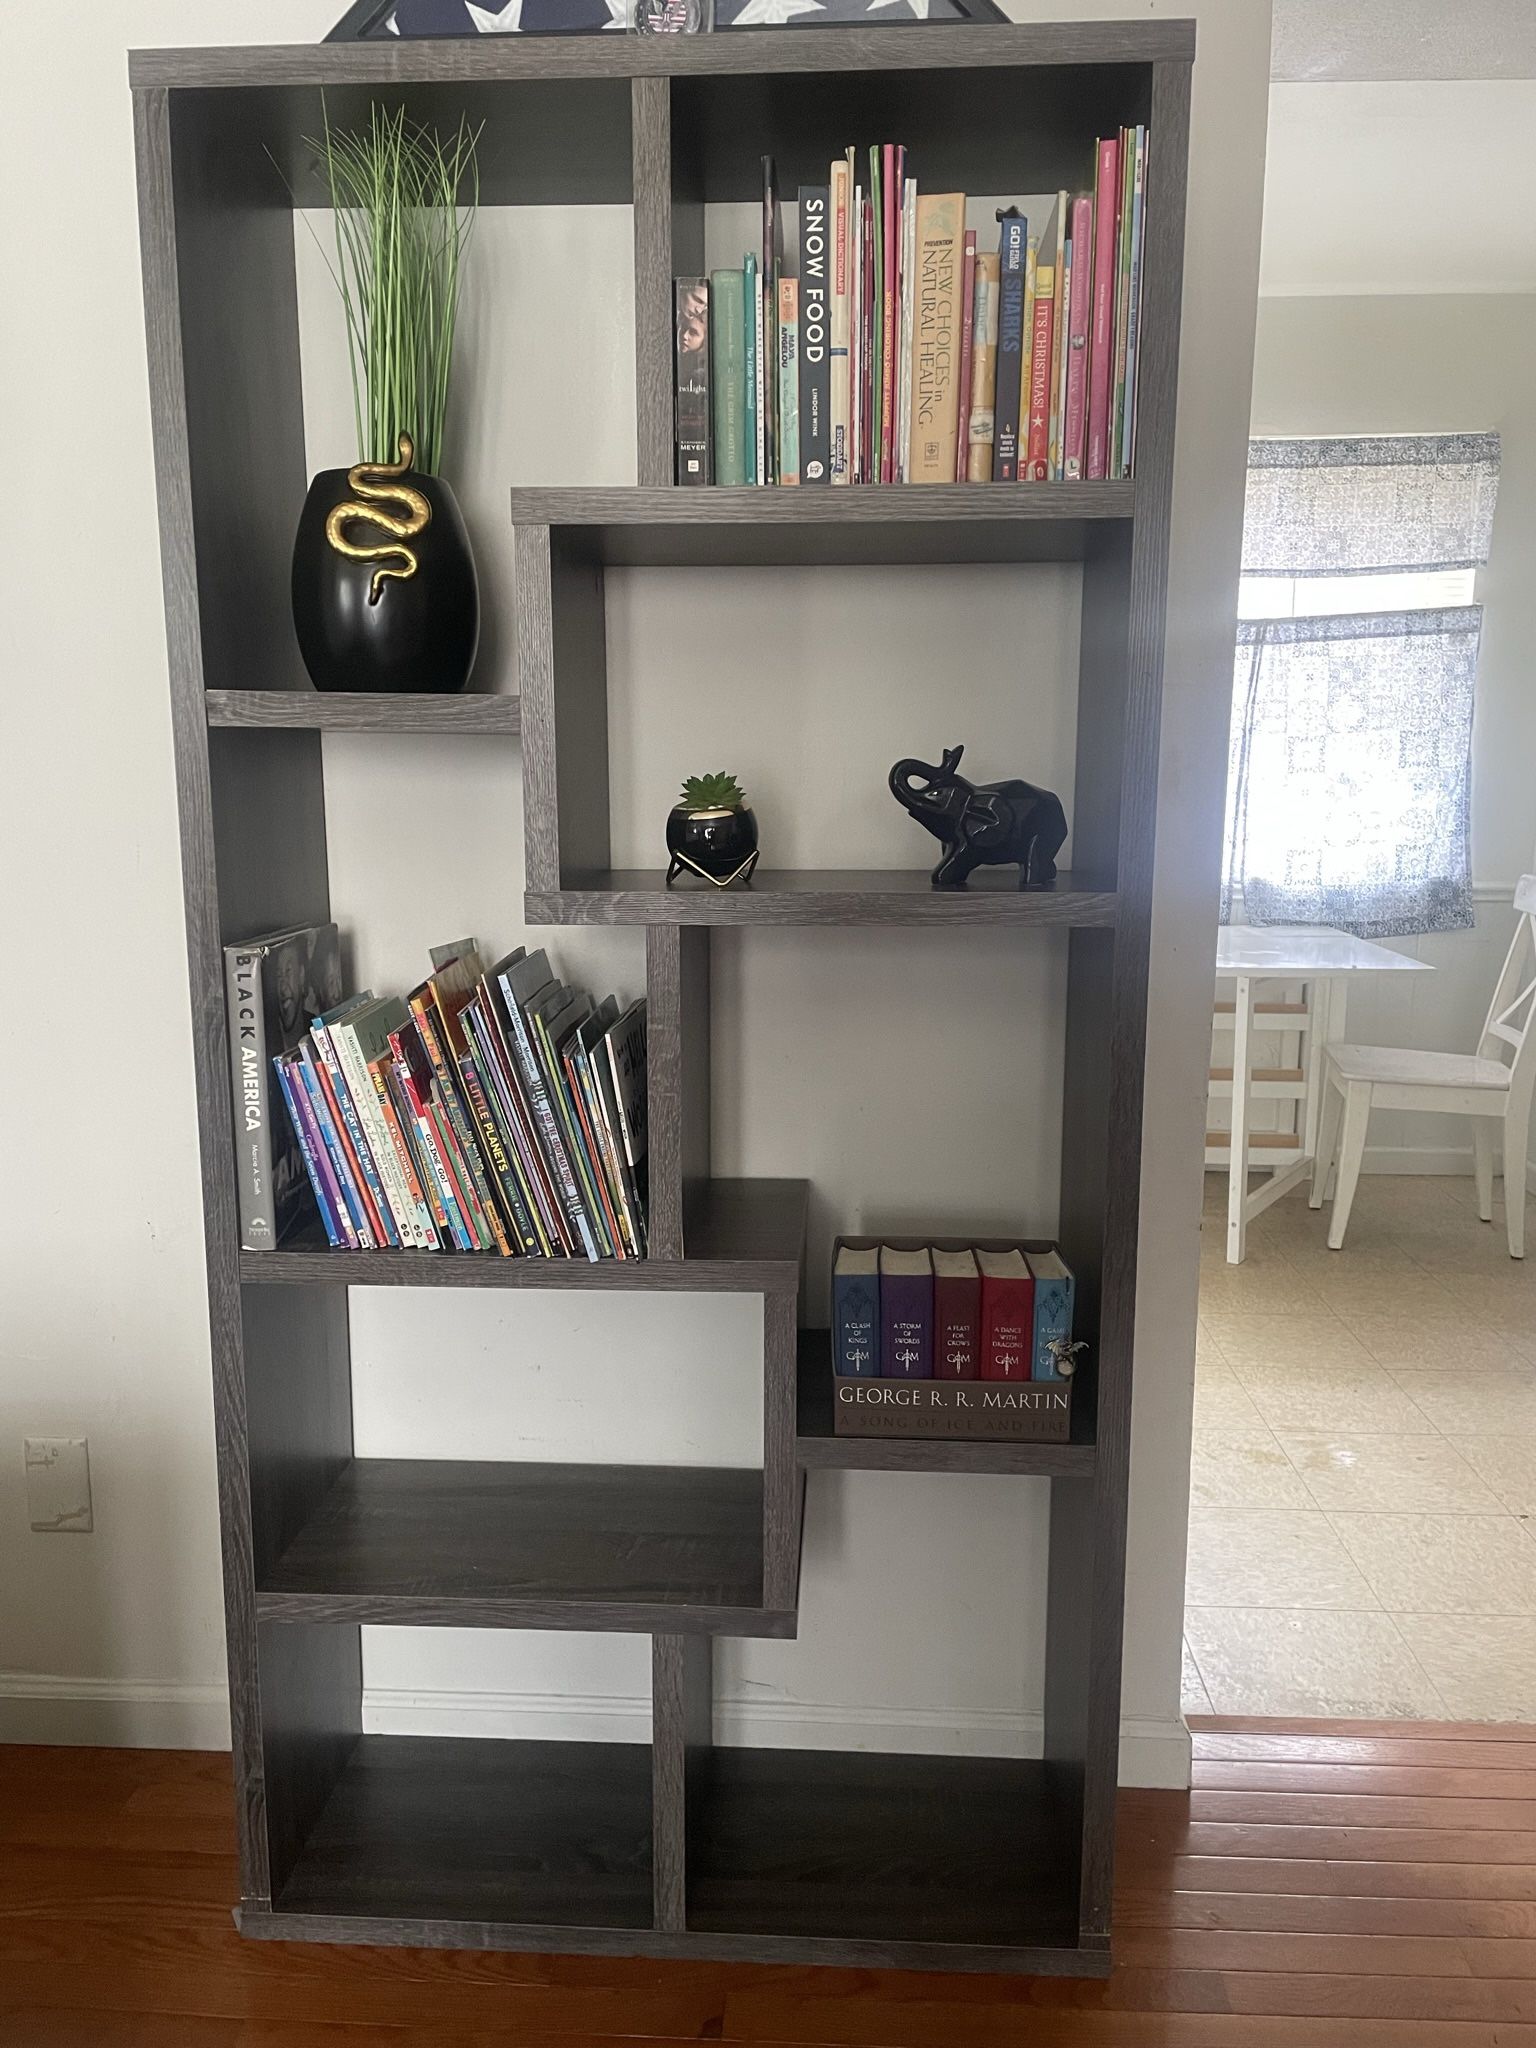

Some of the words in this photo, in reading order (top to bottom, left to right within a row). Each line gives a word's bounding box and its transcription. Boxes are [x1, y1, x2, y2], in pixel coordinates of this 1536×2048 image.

[837, 211, 845, 242] VISUAL
[806, 199, 824, 278] SNOW
[1010, 226, 1021, 249] GO!
[837, 242, 845, 293] DICTIONARY
[938, 248, 954, 296] NEW
[920, 250, 937, 337] NATURAL
[1002, 278, 1022, 352] SHARKS
[1036, 305, 1049, 328] IT'S
[806, 288, 824, 363] FOOD
[935, 300, 952, 386] CHOICES
[1033, 331, 1047, 409] CHRISTMAS!
[679, 379, 706, 394] twilight
[918, 342, 935, 425] HEALING
[934, 390, 945, 402] in
[236, 955, 256, 1040] BLACK
[346, 1035, 358, 1054] VASHTI
[353, 1055, 368, 1082] HARRISON
[512, 1039, 524, 1059] VASHTI
[519, 1059, 533, 1086] HARRISON
[521, 1046, 535, 1071] Morrison
[370, 1073, 385, 1093] PRANK
[395, 1071, 402, 1079] MY
[464, 1071, 474, 1079] 8
[241, 1046, 261, 1132] AMERICA
[339, 1094, 350, 1109] THE
[376, 1093, 388, 1105] DAY
[467, 1081, 489, 1119] LITTLE
[345, 1110, 357, 1128] CAT
[542, 1112, 553, 1124] GOT
[294, 1121, 304, 1136] White
[351, 1129, 361, 1139] IN
[547, 1125, 557, 1136] THE
[300, 1138, 308, 1149] and
[304, 1134, 319, 1161] Cinderella
[356, 1140, 368, 1156] THE
[388, 1121, 398, 1138] KEL
[393, 1140, 414, 1184] MITCHELL
[481, 1121, 508, 1172] PLANETS
[551, 1137, 568, 1169] CHRISTMAS
[251, 1143, 259, 1167] Marcia
[304, 1150, 312, 1159] the
[388, 1157, 396, 1169] BLACK
[429, 1148, 442, 1167] Dog.
[306, 1160, 316, 1175] Seven
[361, 1157, 374, 1175] HAT
[383, 1166, 393, 1182] WOMEN
[435, 1167, 448, 1184] Go!
[253, 1178, 262, 1196] Smith
[338, 1175, 346, 1185] Day
[391, 1170, 403, 1189] HISTORY
[561, 1168, 574, 1187] SPIRIT
[371, 1186, 381, 1195] Dr.
[374, 1193, 386, 1208] Seuss
[503, 1176, 519, 1202] FERRIE
[514, 1208, 528, 1231] DOYLE
[839, 1386, 921, 1405] GEORGE
[931, 1391, 948, 1406] R.
[956, 1392, 973, 1407] R.
[983, 1392, 1068, 1409] MARTIN
[840, 1416, 849, 1425] A
[860, 1415, 907, 1428] SONG
[917, 1417, 936, 1428] OF
[948, 1418, 972, 1429] ICE
[985, 1418, 1022, 1432] AND
[1032, 1421, 1065, 1433] FIRE
